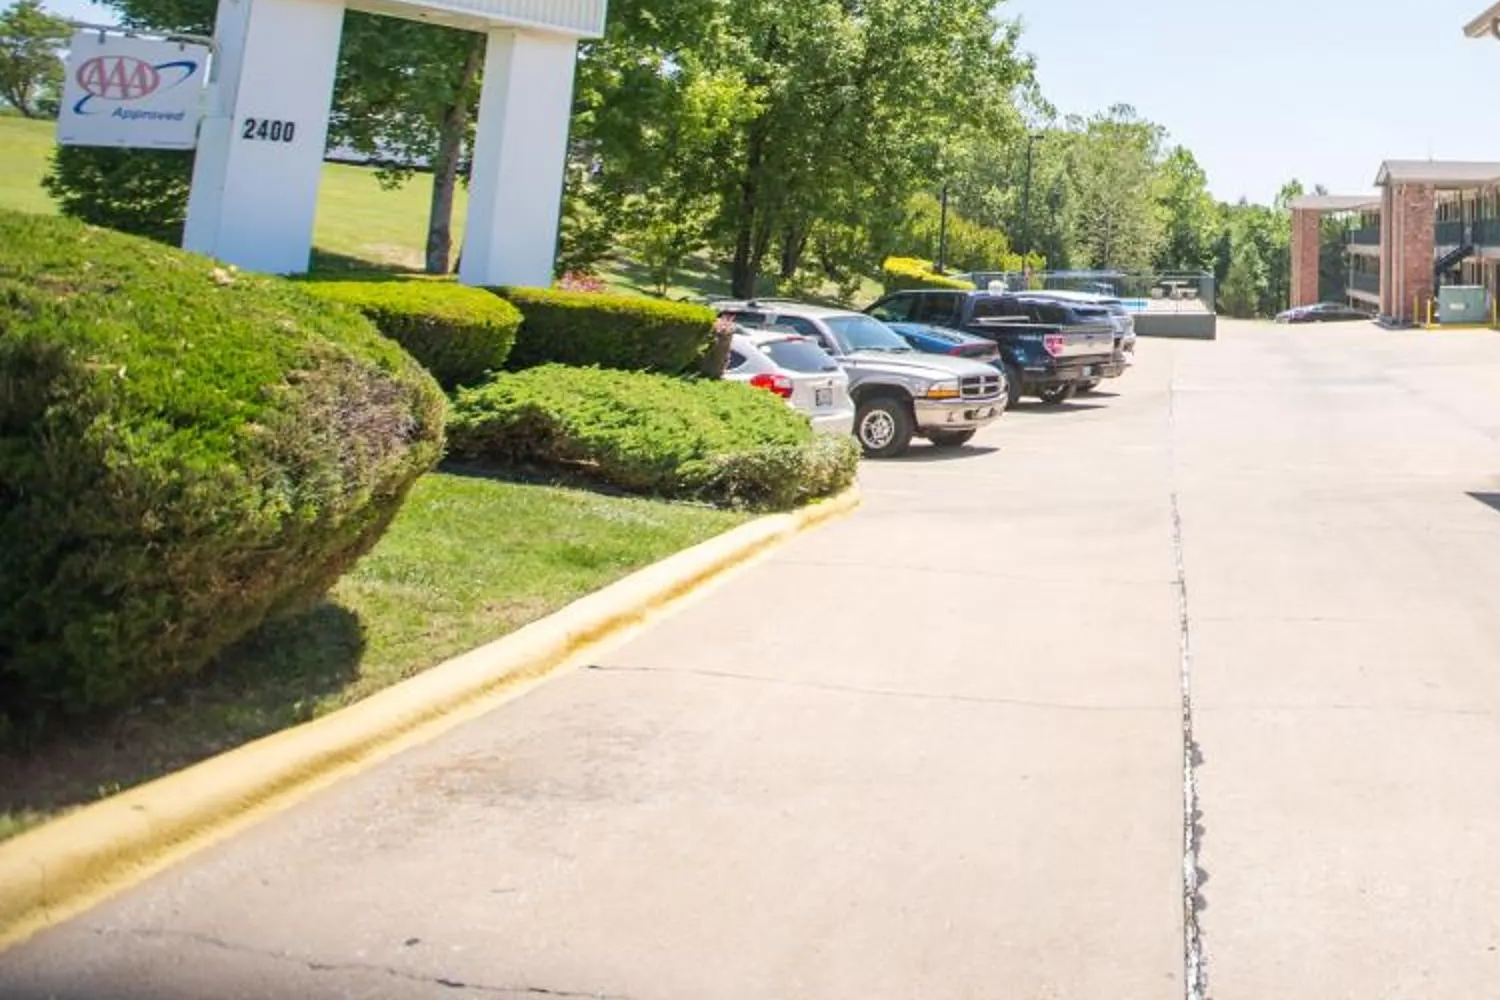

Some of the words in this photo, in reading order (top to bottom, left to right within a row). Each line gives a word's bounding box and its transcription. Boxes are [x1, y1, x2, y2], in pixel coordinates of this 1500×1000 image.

[84, 56, 153, 99] AAA
[112, 107, 185, 121] Approved
[243, 118, 295, 142] 2400
